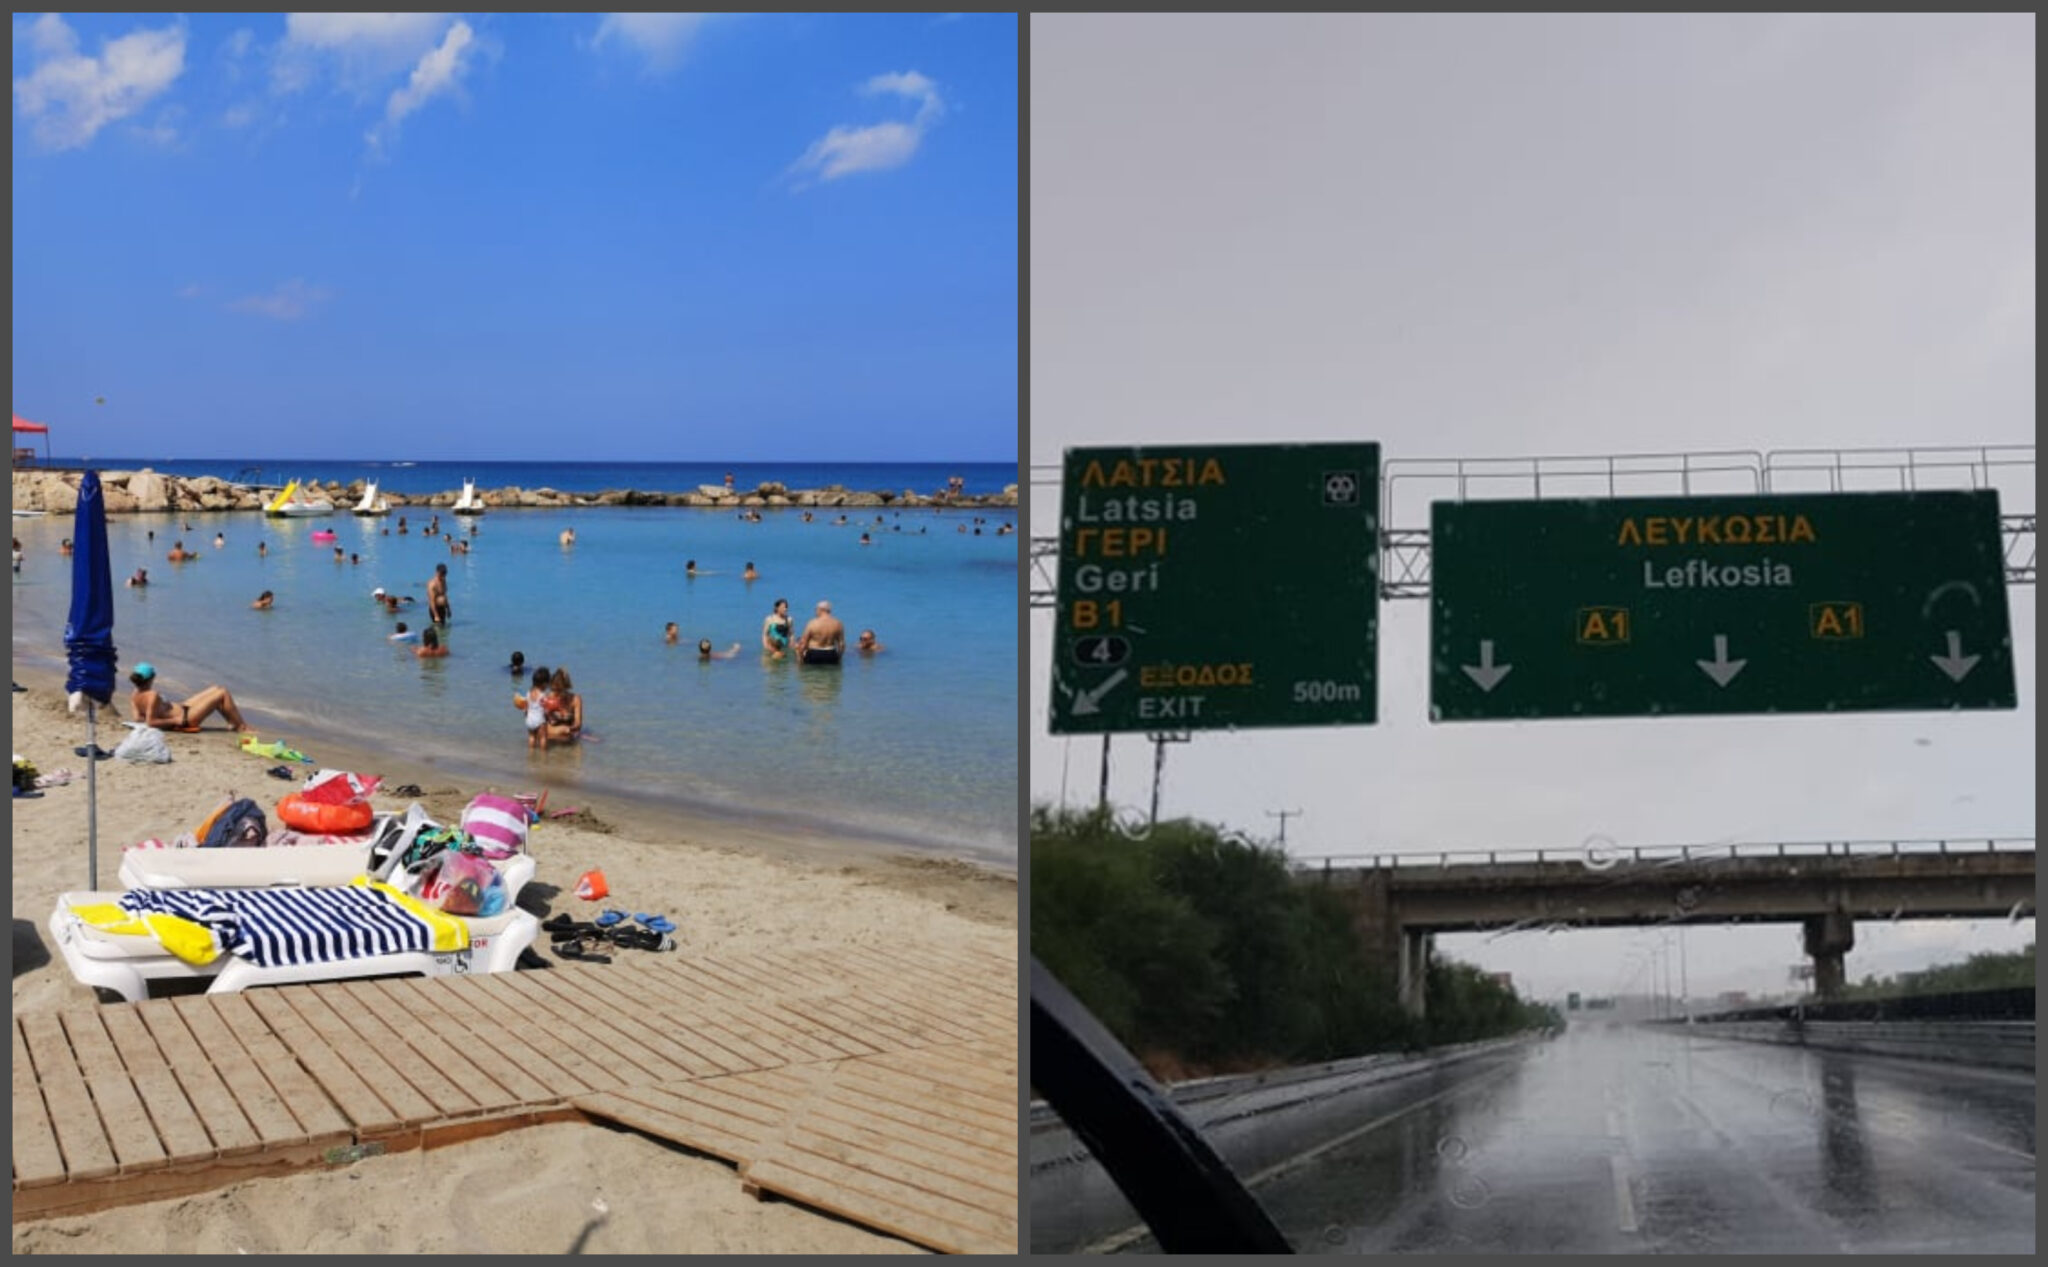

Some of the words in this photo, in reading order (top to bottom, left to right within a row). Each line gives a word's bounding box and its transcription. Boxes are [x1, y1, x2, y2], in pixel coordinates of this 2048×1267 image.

[1081, 458, 1225, 487] ΛΑΤΣΙΑ
[1078, 493, 1197, 521] Latsia
[1076, 527, 1166, 556] ΓΕΡΙ
[1617, 514, 1816, 546] ΛΕΥΚΩΣΙΑ
[1644, 558, 1793, 588] Lefkosia
[1072, 600, 1122, 628] B1
[1582, 611, 1626, 639] A1
[1816, 606, 1860, 635] A1
[1091, 638, 1110, 661] 4
[1140, 664, 1254, 688] ΕΞΟΔΟΣ
[1294, 681, 1361, 702] 500m
[1138, 696, 1206, 719] EXIT
